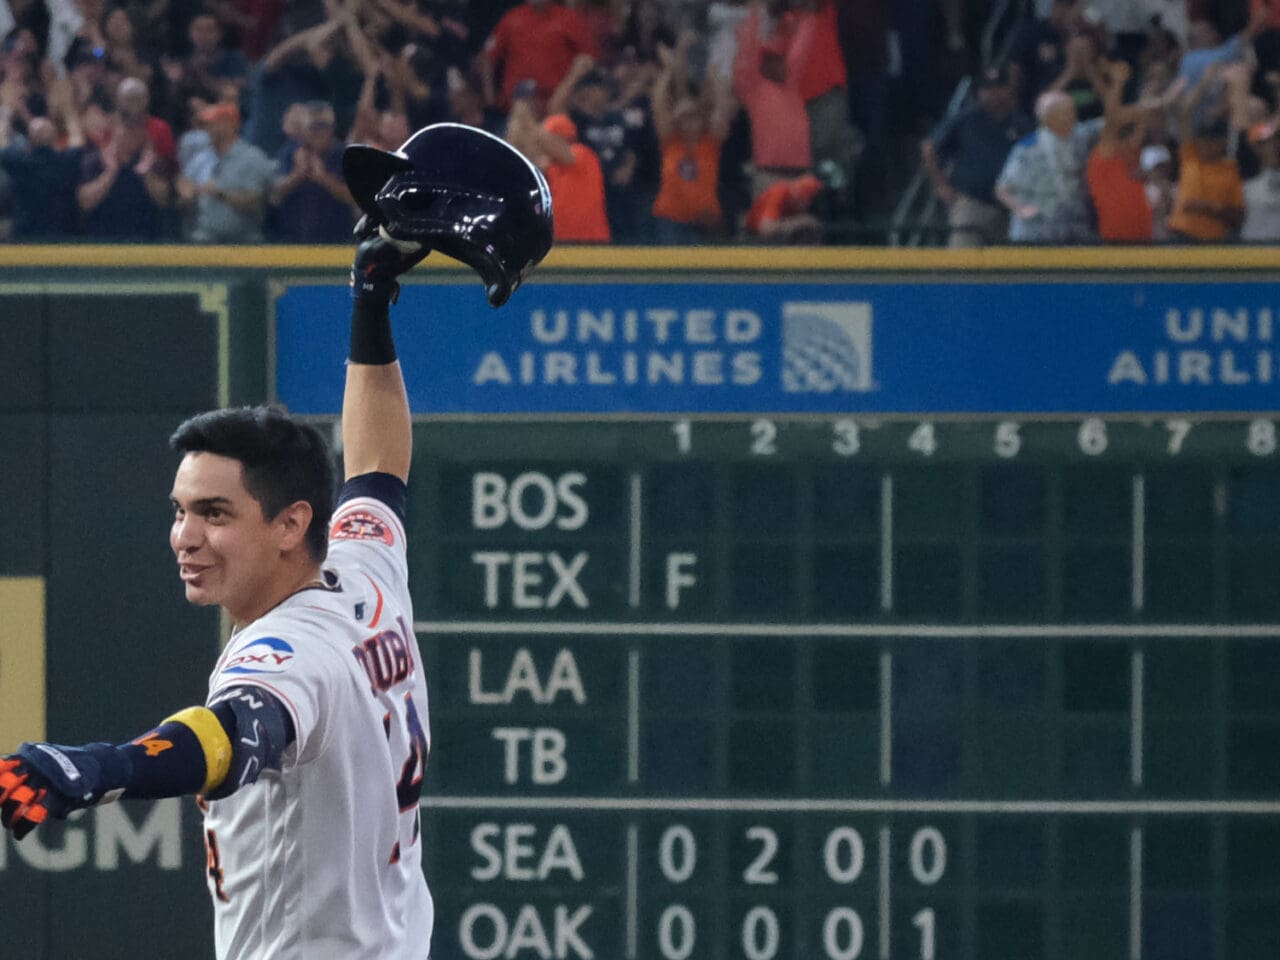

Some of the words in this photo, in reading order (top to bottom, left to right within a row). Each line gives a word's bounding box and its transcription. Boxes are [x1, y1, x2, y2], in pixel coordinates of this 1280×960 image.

[532, 310, 761, 343] UNITED
[474, 352, 762, 385] AIRLINES
[673, 419, 692, 455] 1
[750, 419, 777, 455] 2
[831, 419, 861, 455] 3
[908, 419, 936, 455] 4
[995, 419, 1020, 455] 5
[1078, 419, 1108, 455] 6
[1166, 419, 1192, 455] 7
[1248, 419, 1276, 455] 8
[471, 471, 590, 532] BOS
[472, 551, 589, 609] TEX
[666, 552, 698, 609] F
[468, 648, 587, 705] LAA
[492, 727, 568, 786] TB
[470, 822, 584, 882] SEA
[659, 825, 697, 884] 0
[743, 826, 780, 885] 2
[823, 826, 865, 884] 0
[909, 827, 948, 885] 0
